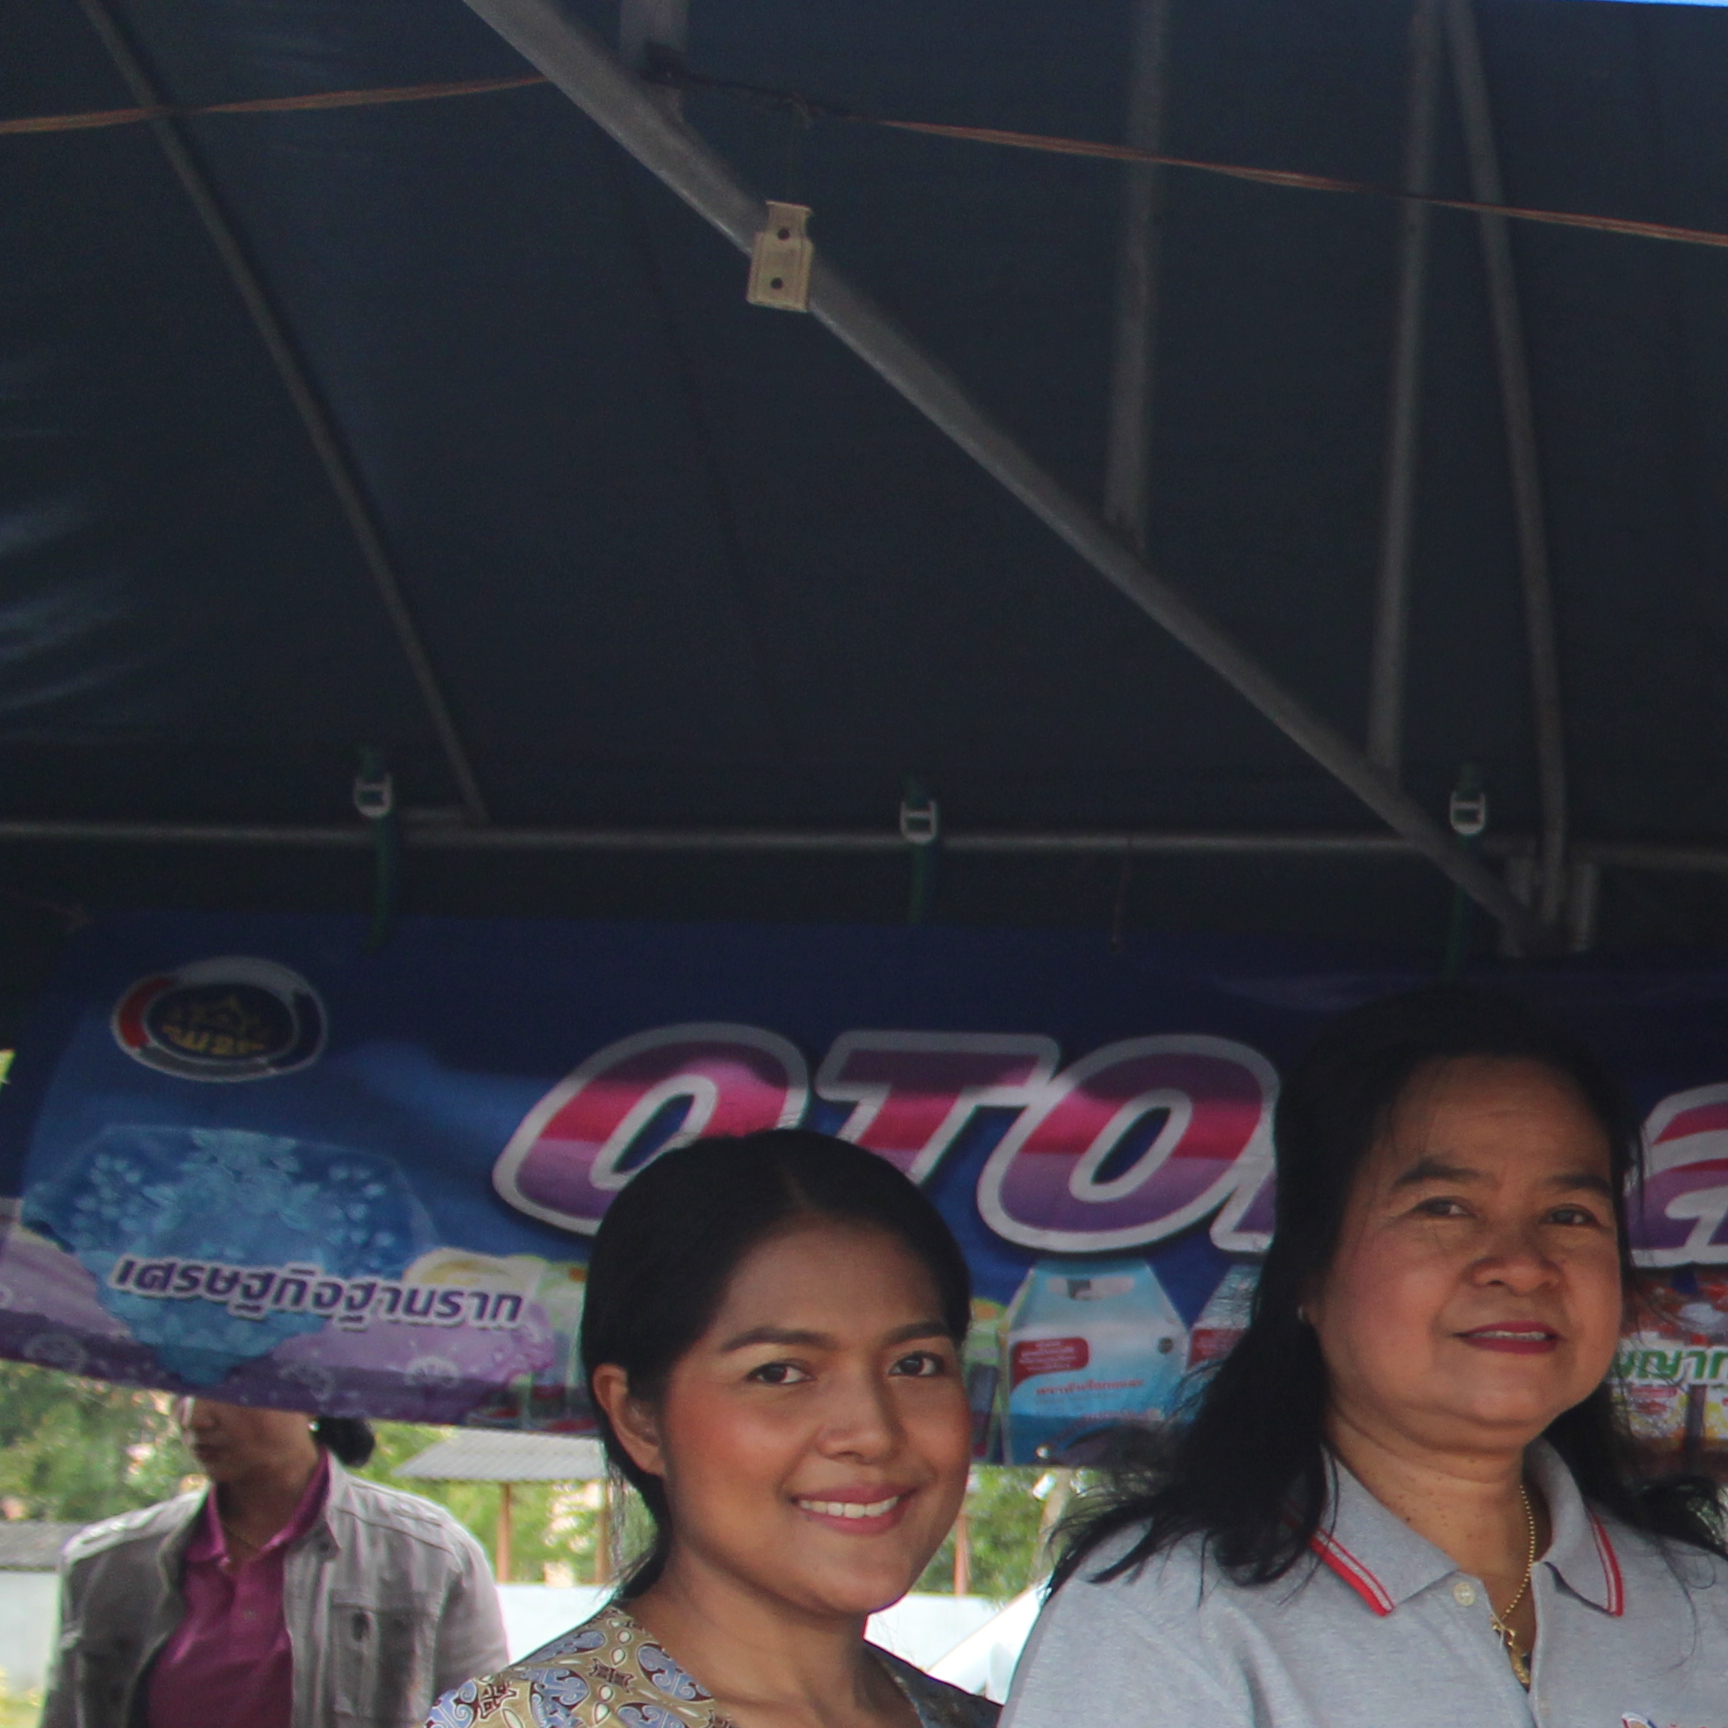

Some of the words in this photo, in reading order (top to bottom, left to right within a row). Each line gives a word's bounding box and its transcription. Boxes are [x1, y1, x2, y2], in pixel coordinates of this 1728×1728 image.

[493, 1023, 1280, 1253] OTO
[112, 1257, 526, 1327] เศรษฐกิจฐานราก
